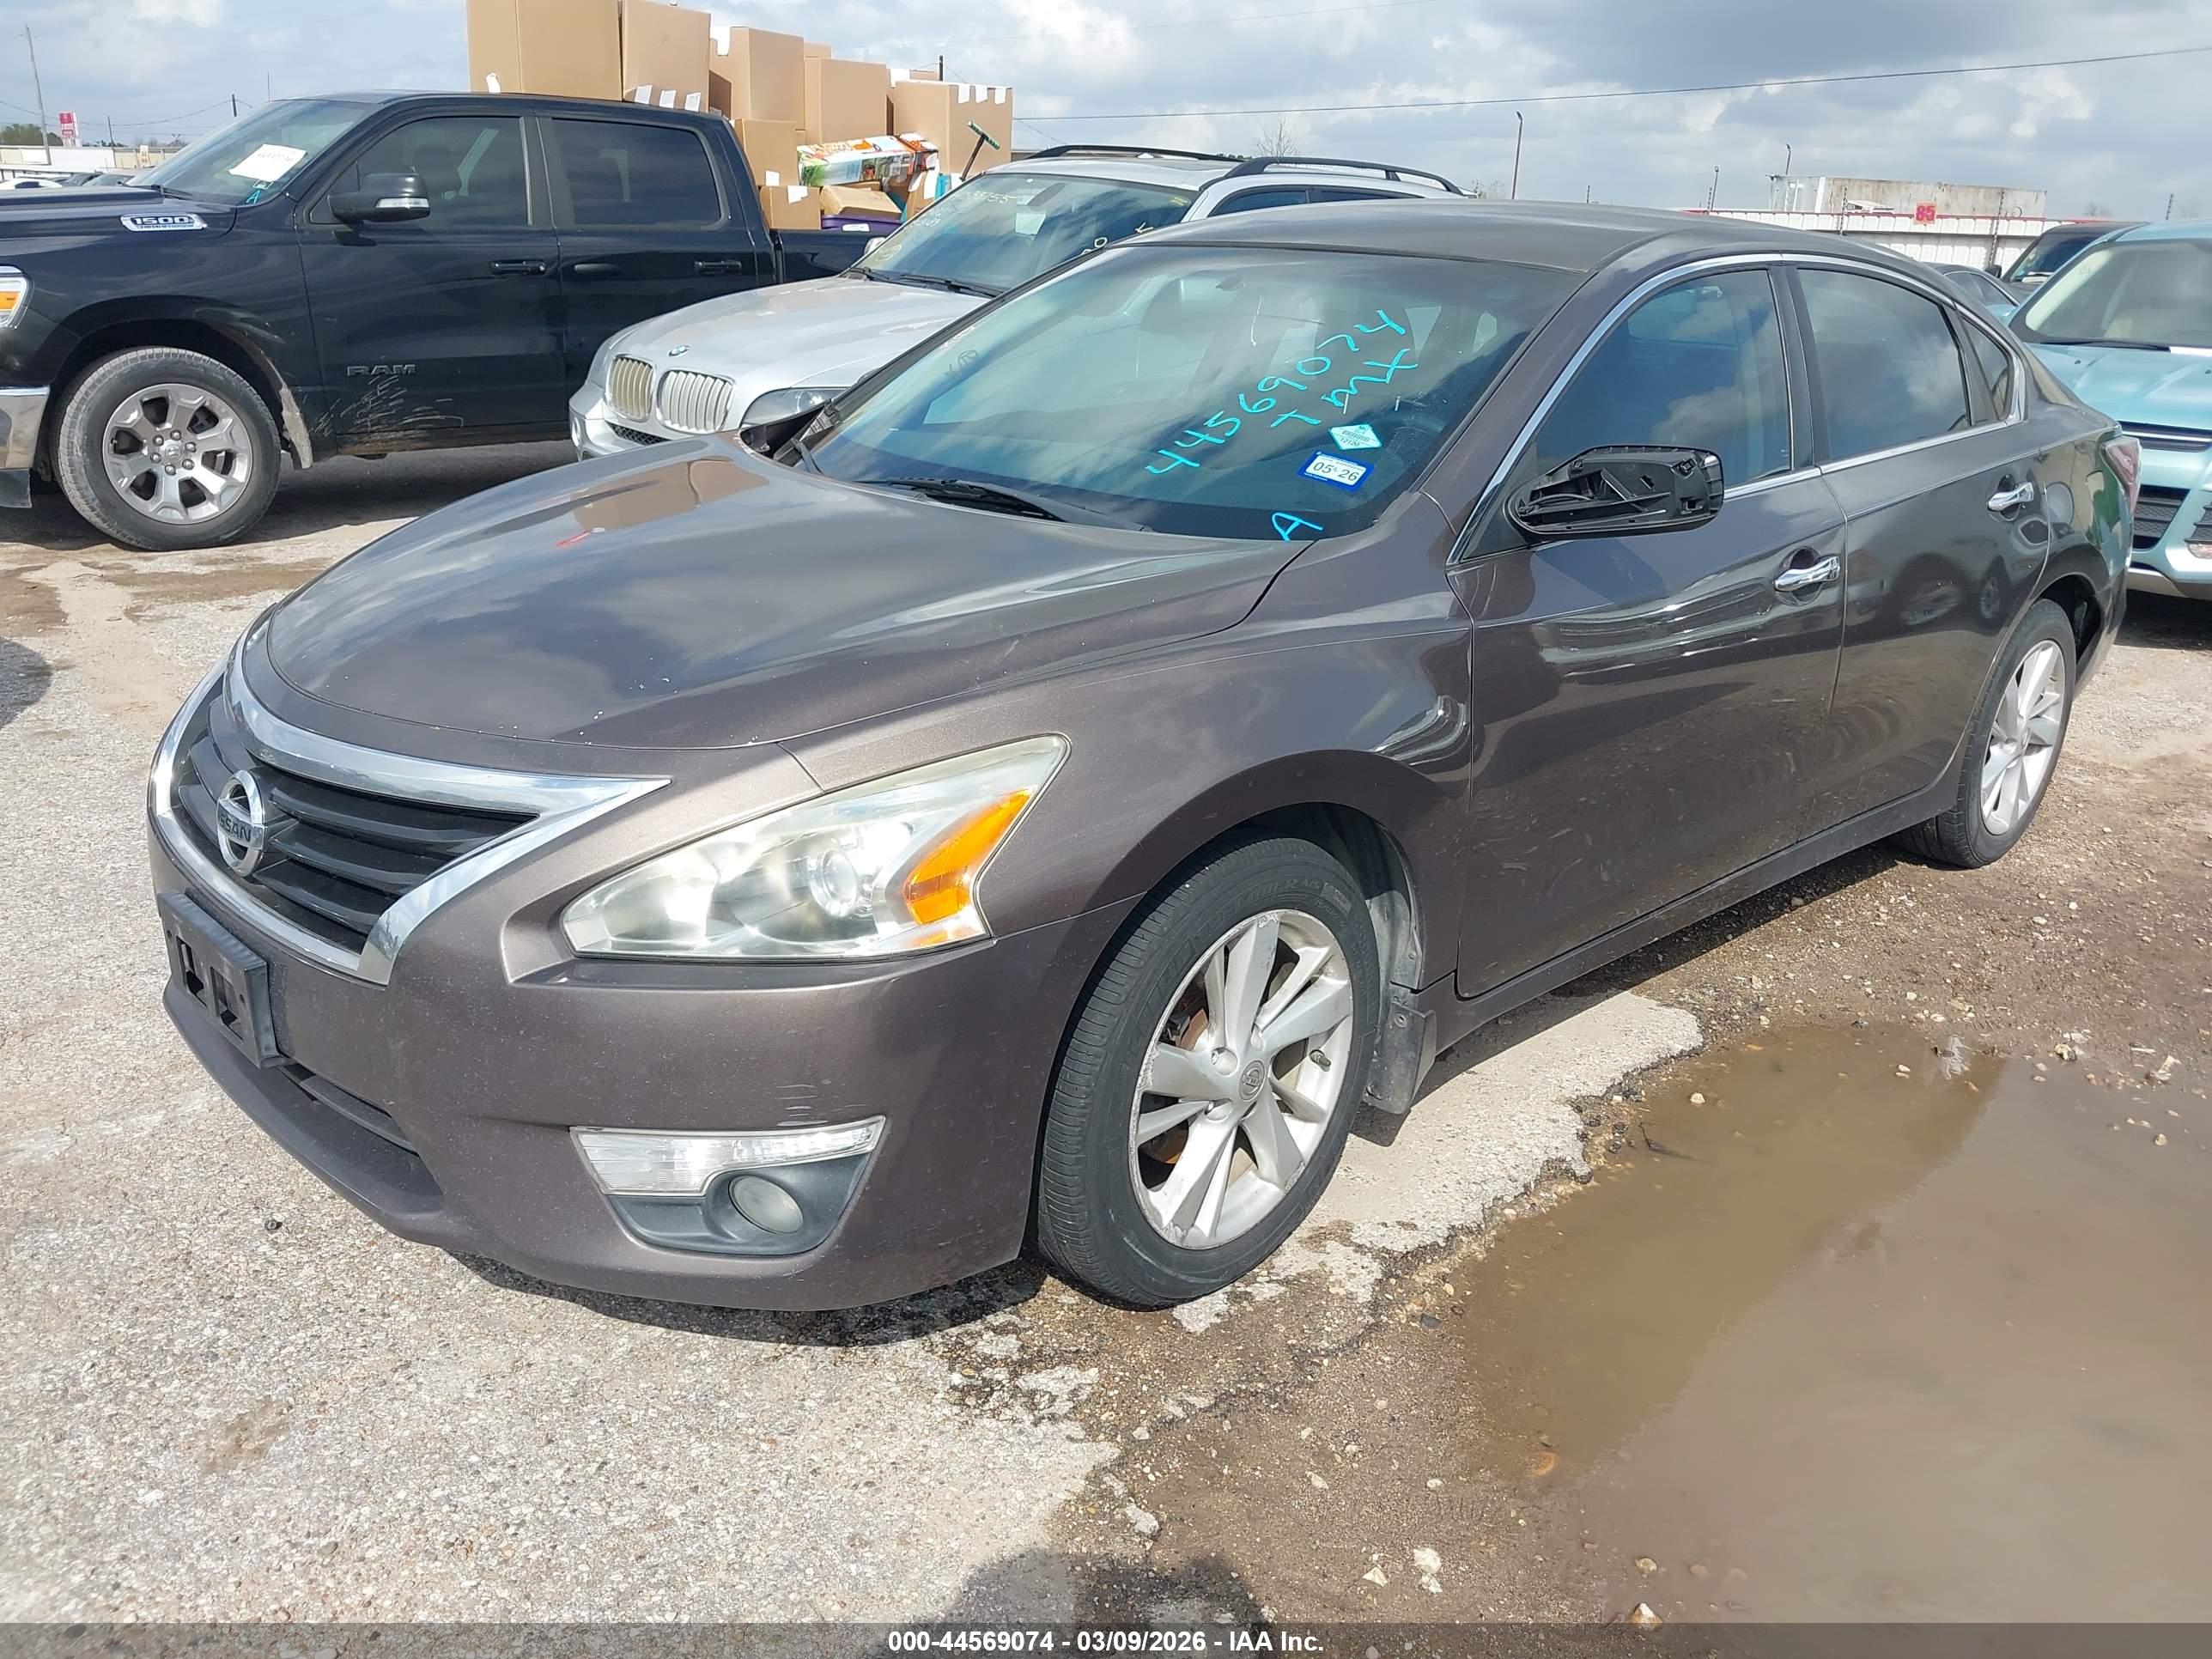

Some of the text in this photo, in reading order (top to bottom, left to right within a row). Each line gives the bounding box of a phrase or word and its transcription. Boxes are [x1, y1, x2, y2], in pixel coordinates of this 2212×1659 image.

[246, 189, 261, 204] A
[132, 216, 189, 225] 1500
[1916, 205, 1935, 221] 85
[347, 364, 416, 376] RAM
[1272, 513, 1324, 542] A
